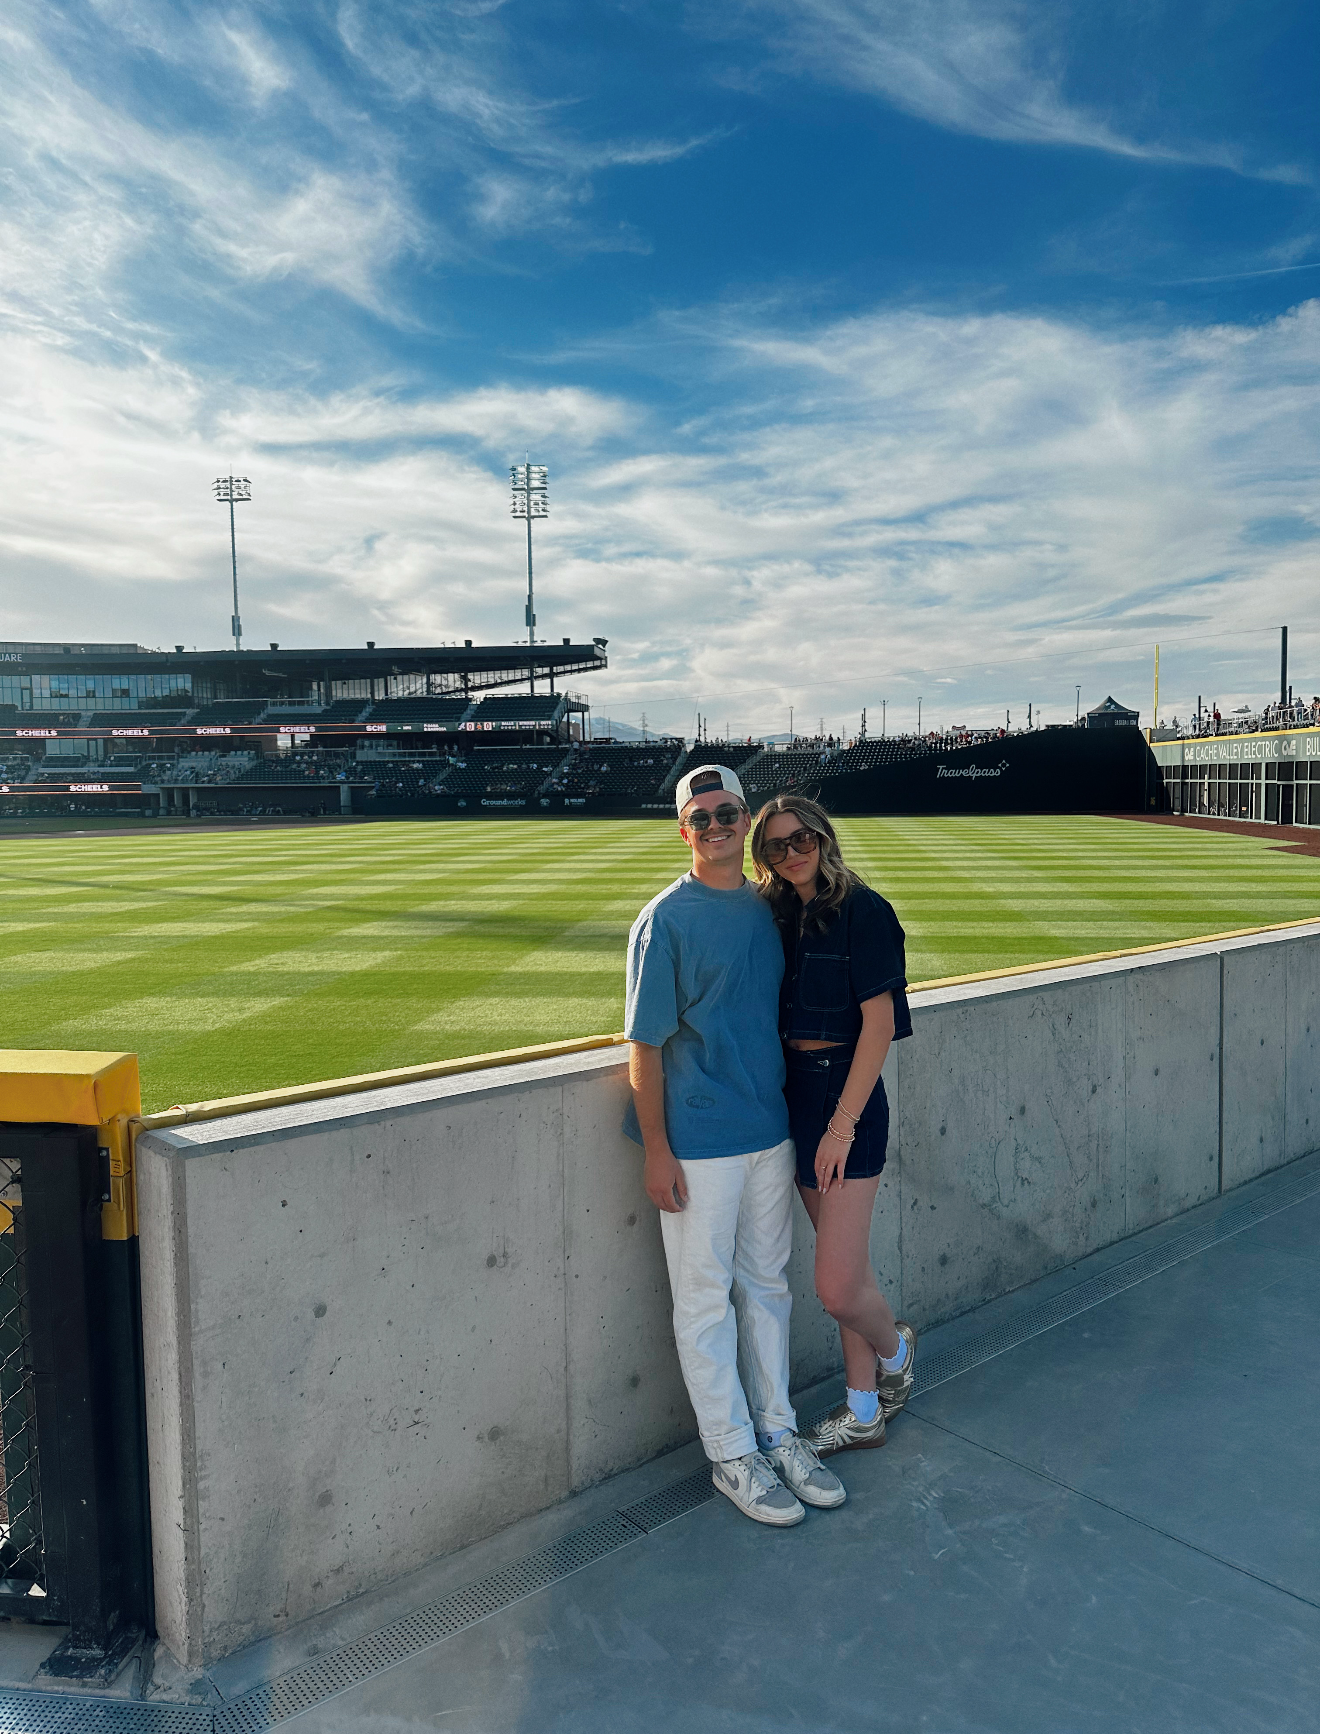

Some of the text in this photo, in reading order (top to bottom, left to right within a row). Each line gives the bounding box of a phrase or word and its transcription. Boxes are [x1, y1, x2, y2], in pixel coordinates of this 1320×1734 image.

[15, 729, 58, 737] SCHEELS
[196, 727, 231, 735] SCHEELS
[1195, 745, 1217, 761] CACHE
[1218, 742, 1243, 760] VALLEY
[1243, 739, 1279, 759] ELECTRIC
[936, 764, 1001, 781] Travelpass
[69, 784, 109, 792] SCHEELS
[480, 798, 526, 806] Groundworks
